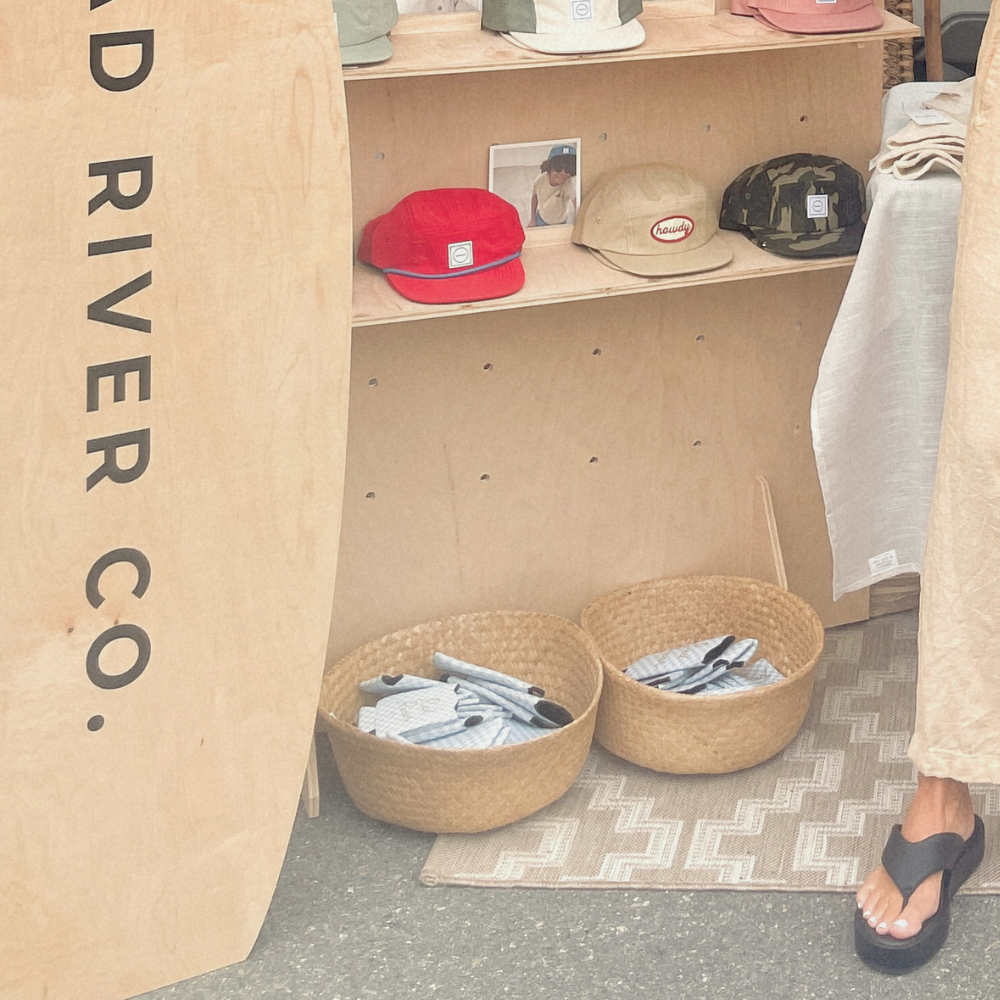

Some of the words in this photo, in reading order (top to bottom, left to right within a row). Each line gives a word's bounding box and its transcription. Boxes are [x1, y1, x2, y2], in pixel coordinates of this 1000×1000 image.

[656, 221, 691, 237] howdy
[86, 155, 154, 493] RIVER
[86, 547, 152, 732] CO.
